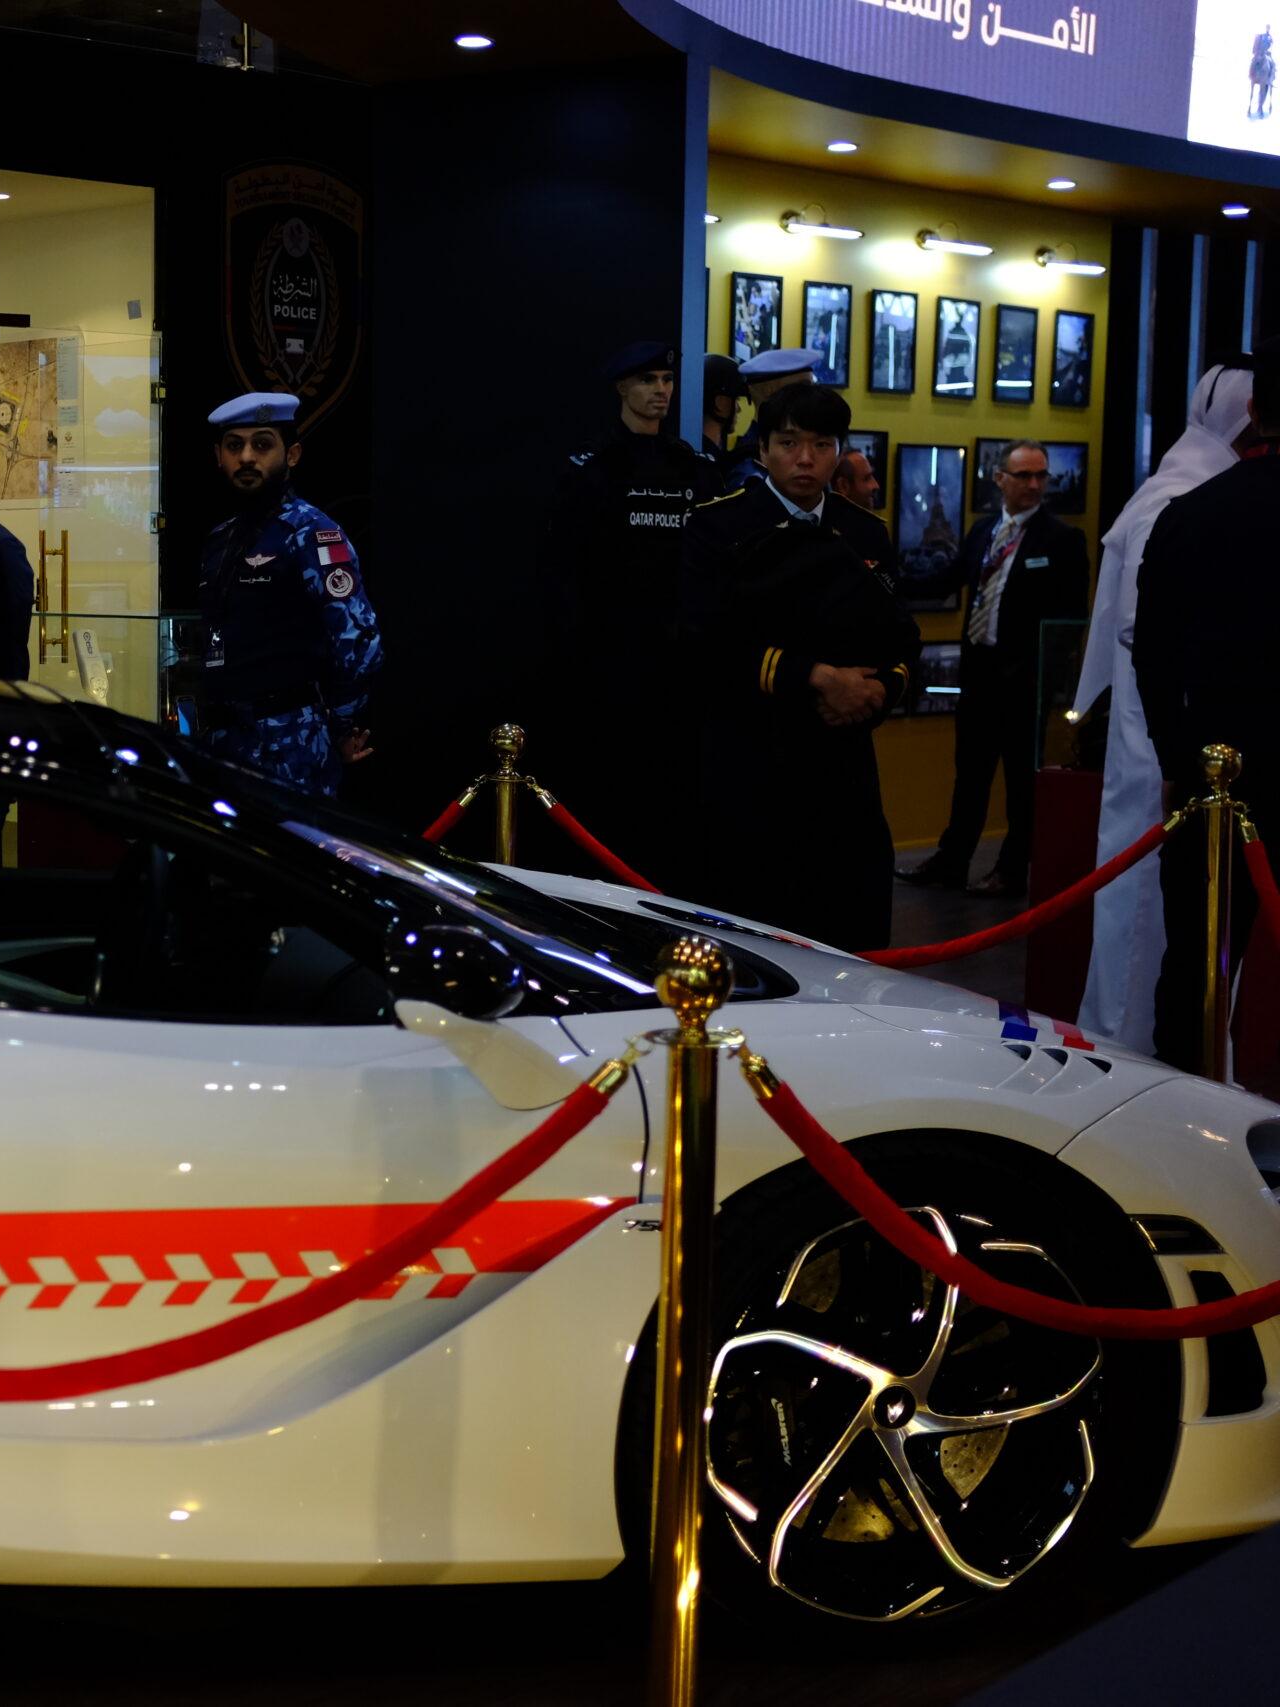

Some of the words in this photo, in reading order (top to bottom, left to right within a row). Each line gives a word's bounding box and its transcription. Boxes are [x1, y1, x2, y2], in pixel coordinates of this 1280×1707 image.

[272, 273, 318, 302] الشرطة
[273, 304, 317, 321] POLICE
[629, 511, 654, 526] QATAR
[654, 513, 681, 528] POLICE
